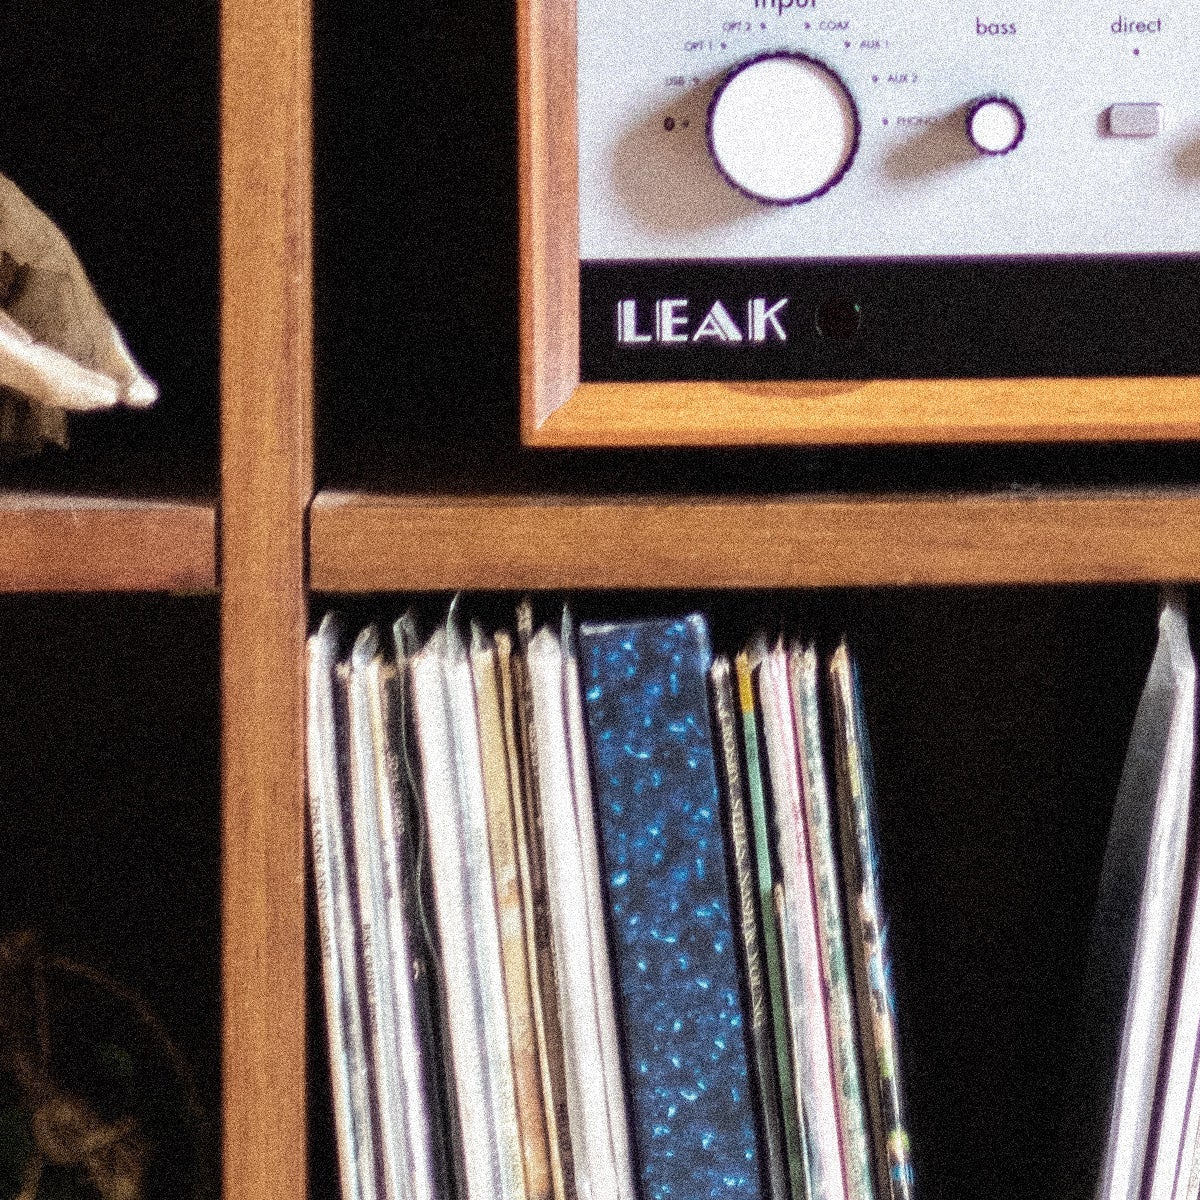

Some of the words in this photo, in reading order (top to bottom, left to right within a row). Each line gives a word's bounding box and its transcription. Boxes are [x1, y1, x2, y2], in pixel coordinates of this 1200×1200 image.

[975, 16, 1018, 36] bass
[1110, 15, 1162, 34] direct
[616, 298, 789, 343] LEAK
